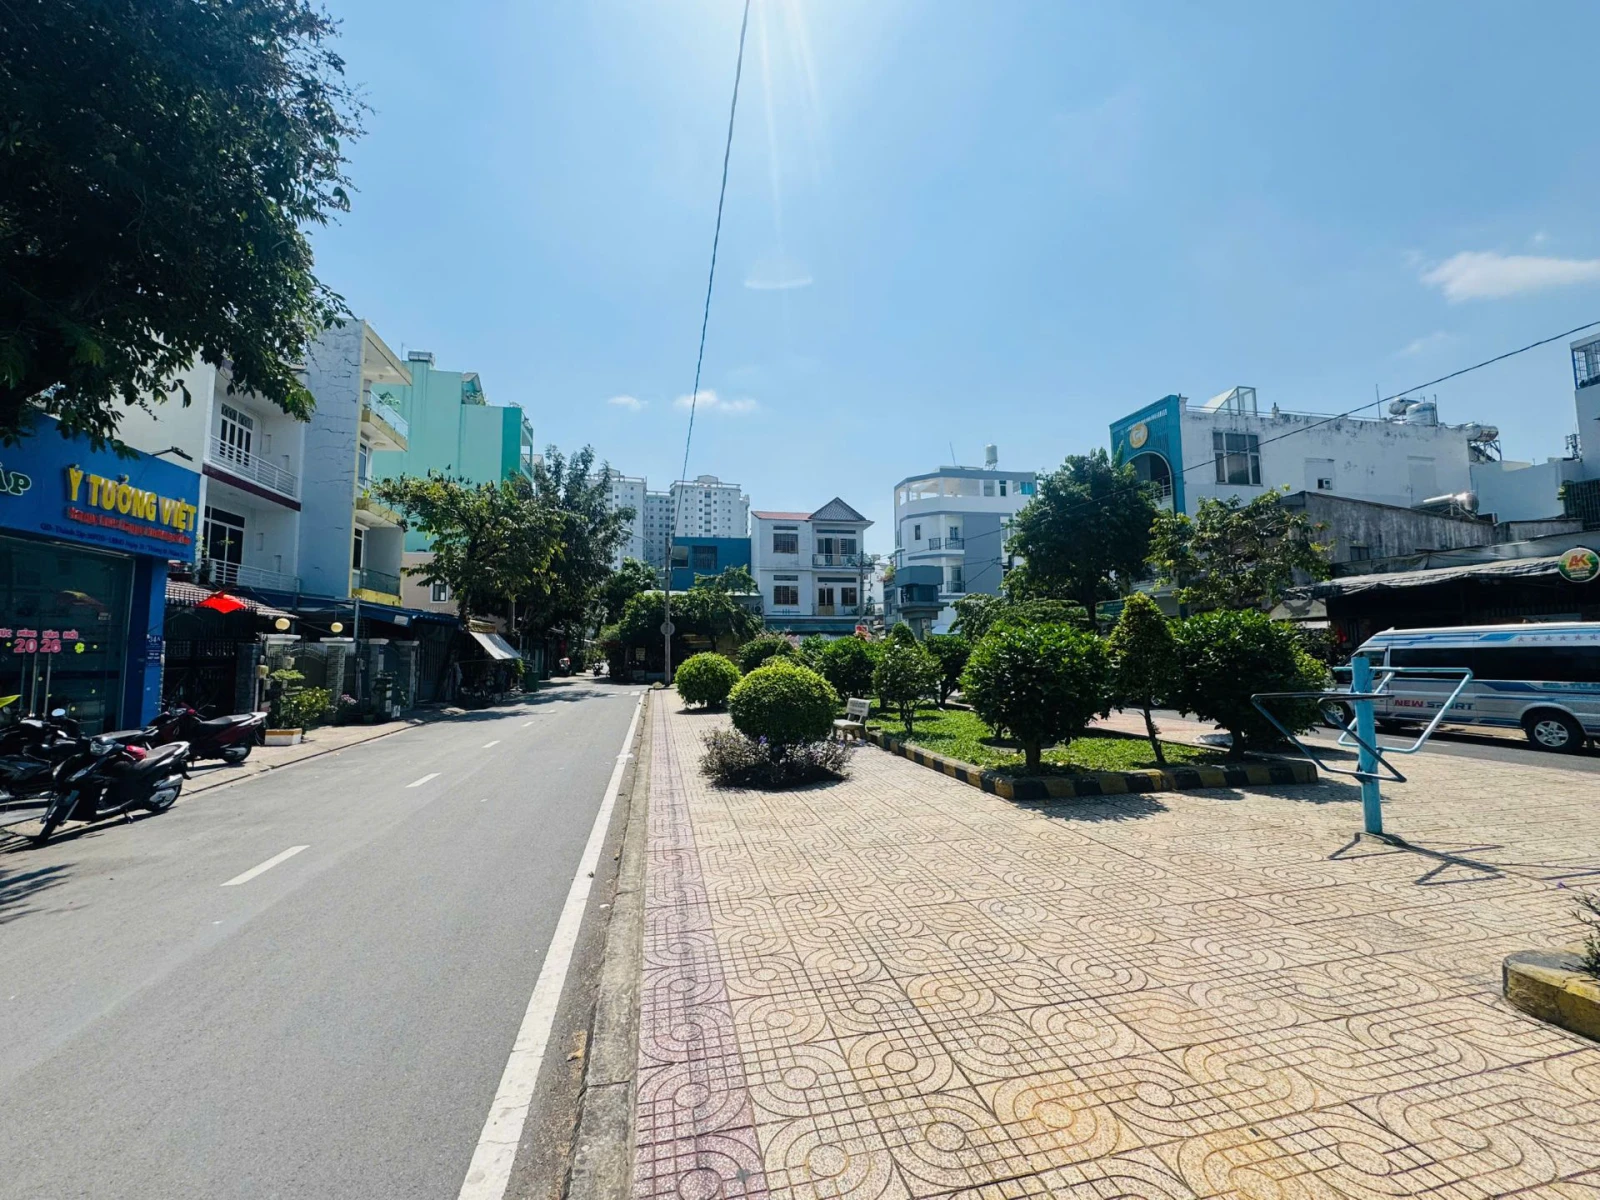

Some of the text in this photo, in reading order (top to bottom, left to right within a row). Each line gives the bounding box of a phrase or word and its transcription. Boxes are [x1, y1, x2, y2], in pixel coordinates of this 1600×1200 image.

[87, 474, 156, 521] TƯỞNG
[160, 496, 197, 532] VIỆT
[1394, 699, 1424, 708] NEW
